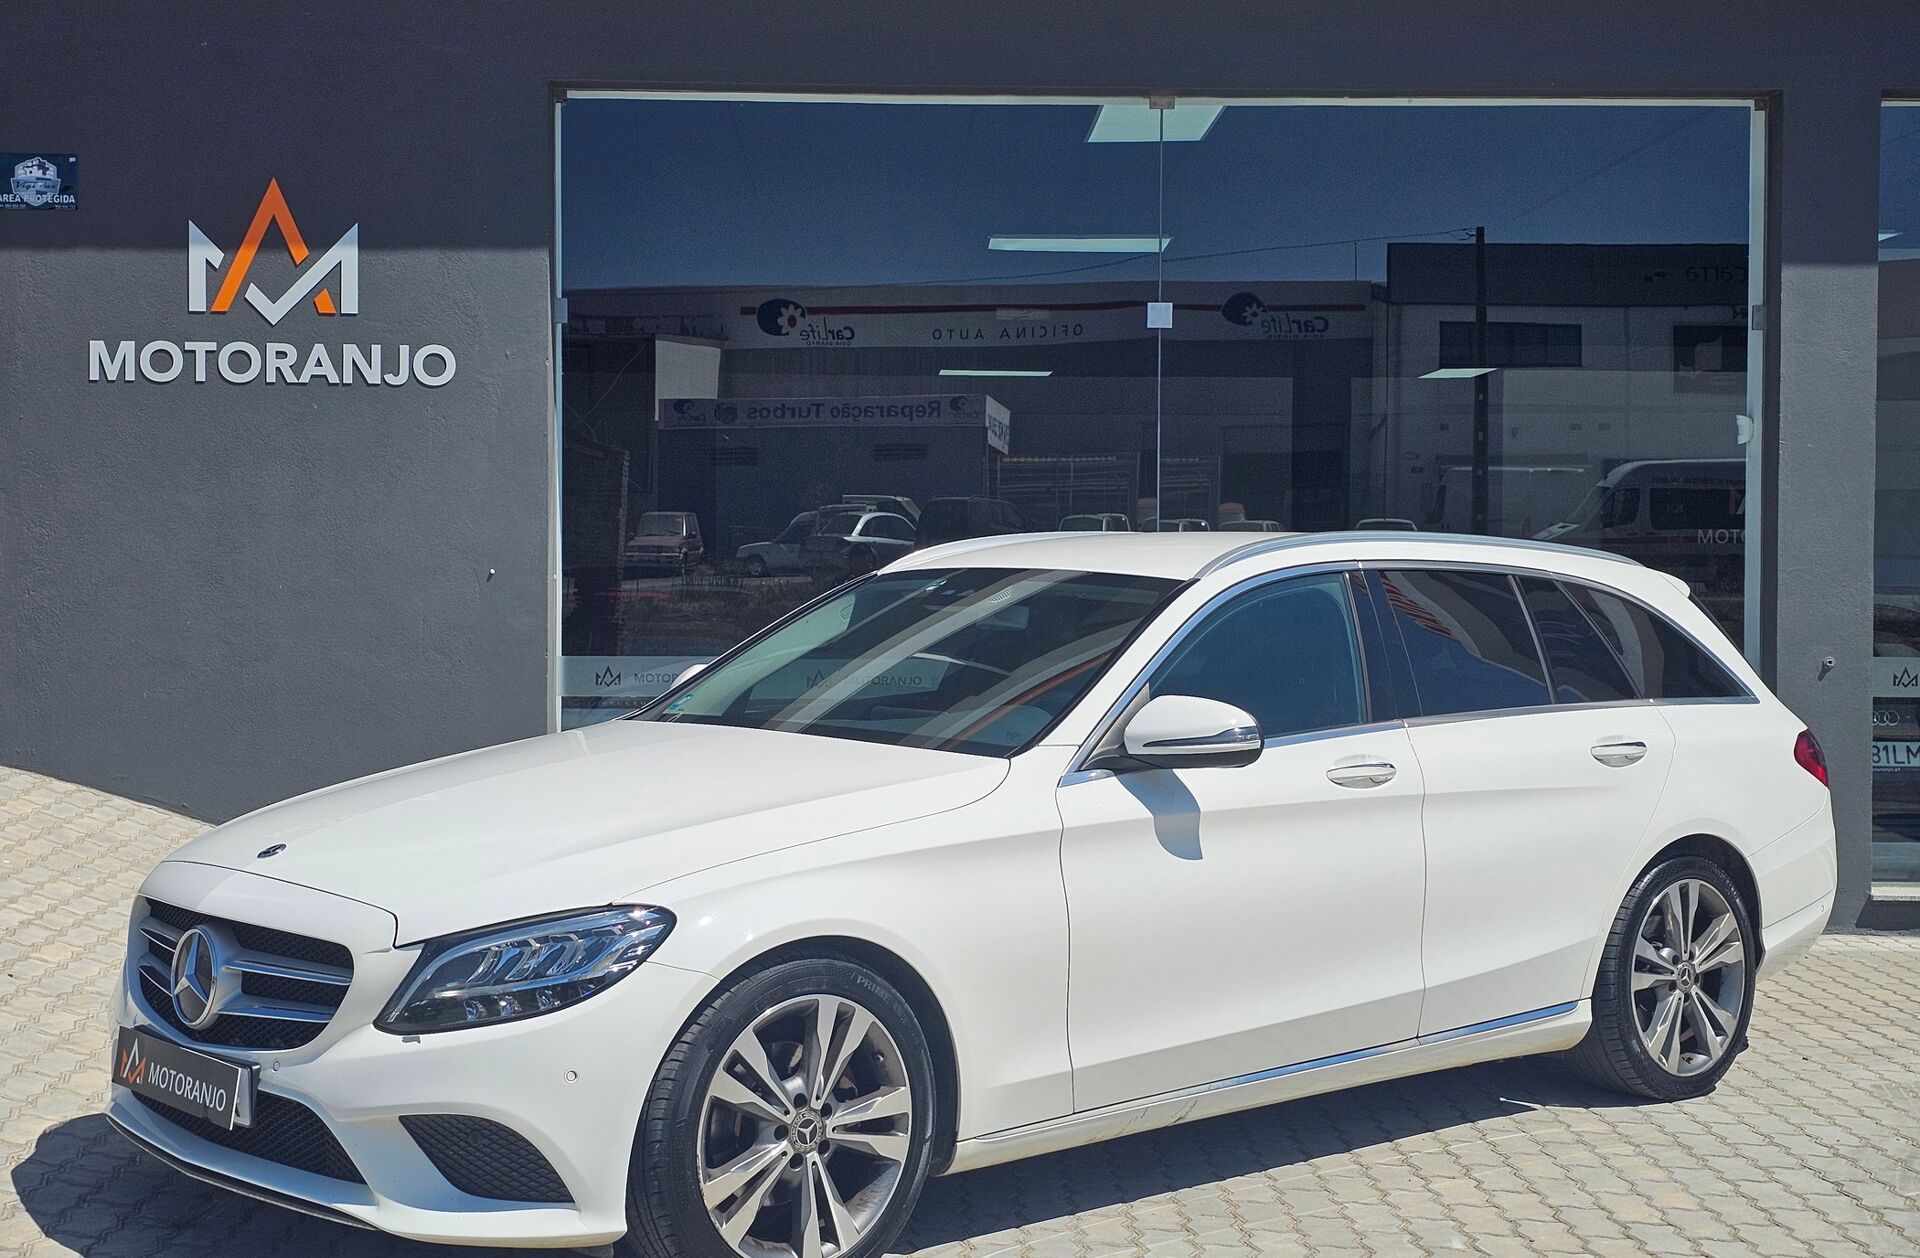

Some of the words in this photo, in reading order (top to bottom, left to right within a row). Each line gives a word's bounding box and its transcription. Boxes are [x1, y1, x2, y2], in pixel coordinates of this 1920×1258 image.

[24, 194, 75, 203] PROTEGIDA
[88, 340, 457, 387] MOTORANJO
[147, 1061, 226, 1112] MOTORANJO
